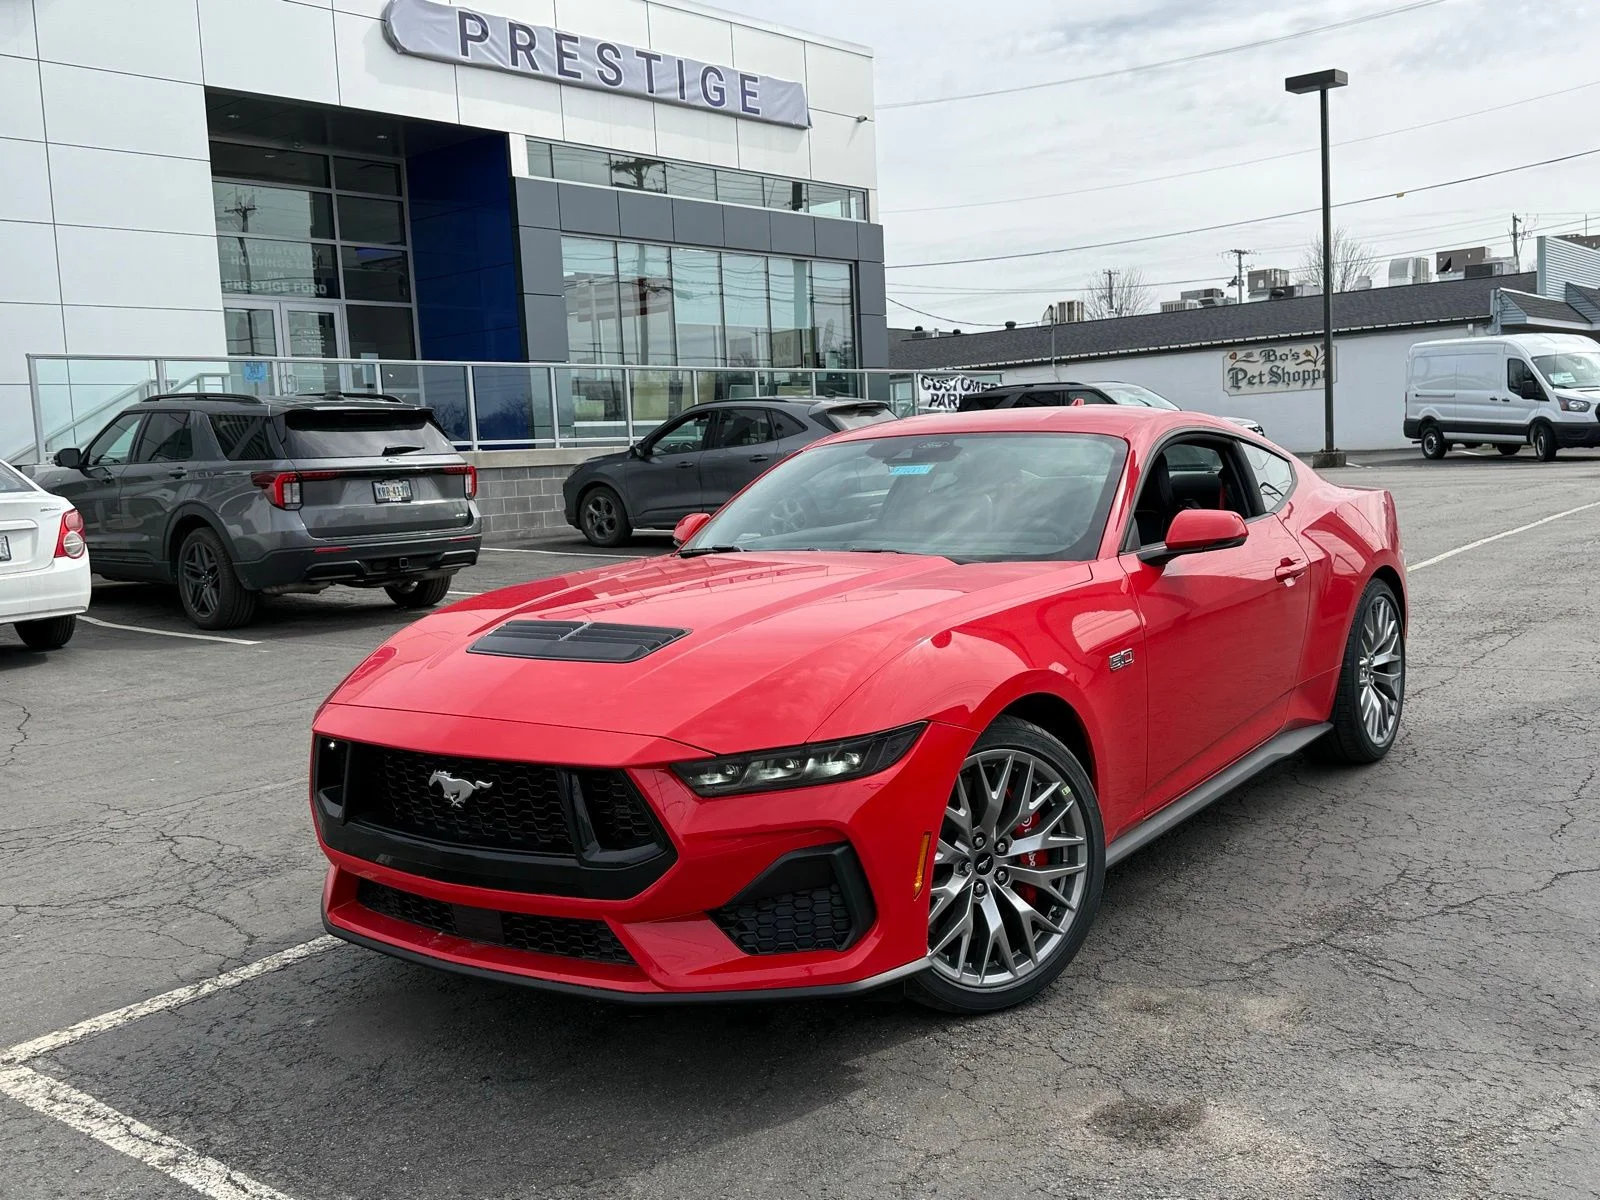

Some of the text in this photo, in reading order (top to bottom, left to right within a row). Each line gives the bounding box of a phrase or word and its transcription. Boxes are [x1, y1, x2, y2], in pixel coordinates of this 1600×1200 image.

[457, 10, 762, 115] PRESTIGE
[294, 282, 328, 294] FORD
[1260, 348, 1300, 363] Bo's
[1227, 364, 1326, 389] Pet Shopp
[1109, 648, 1134, 671] 5.0
